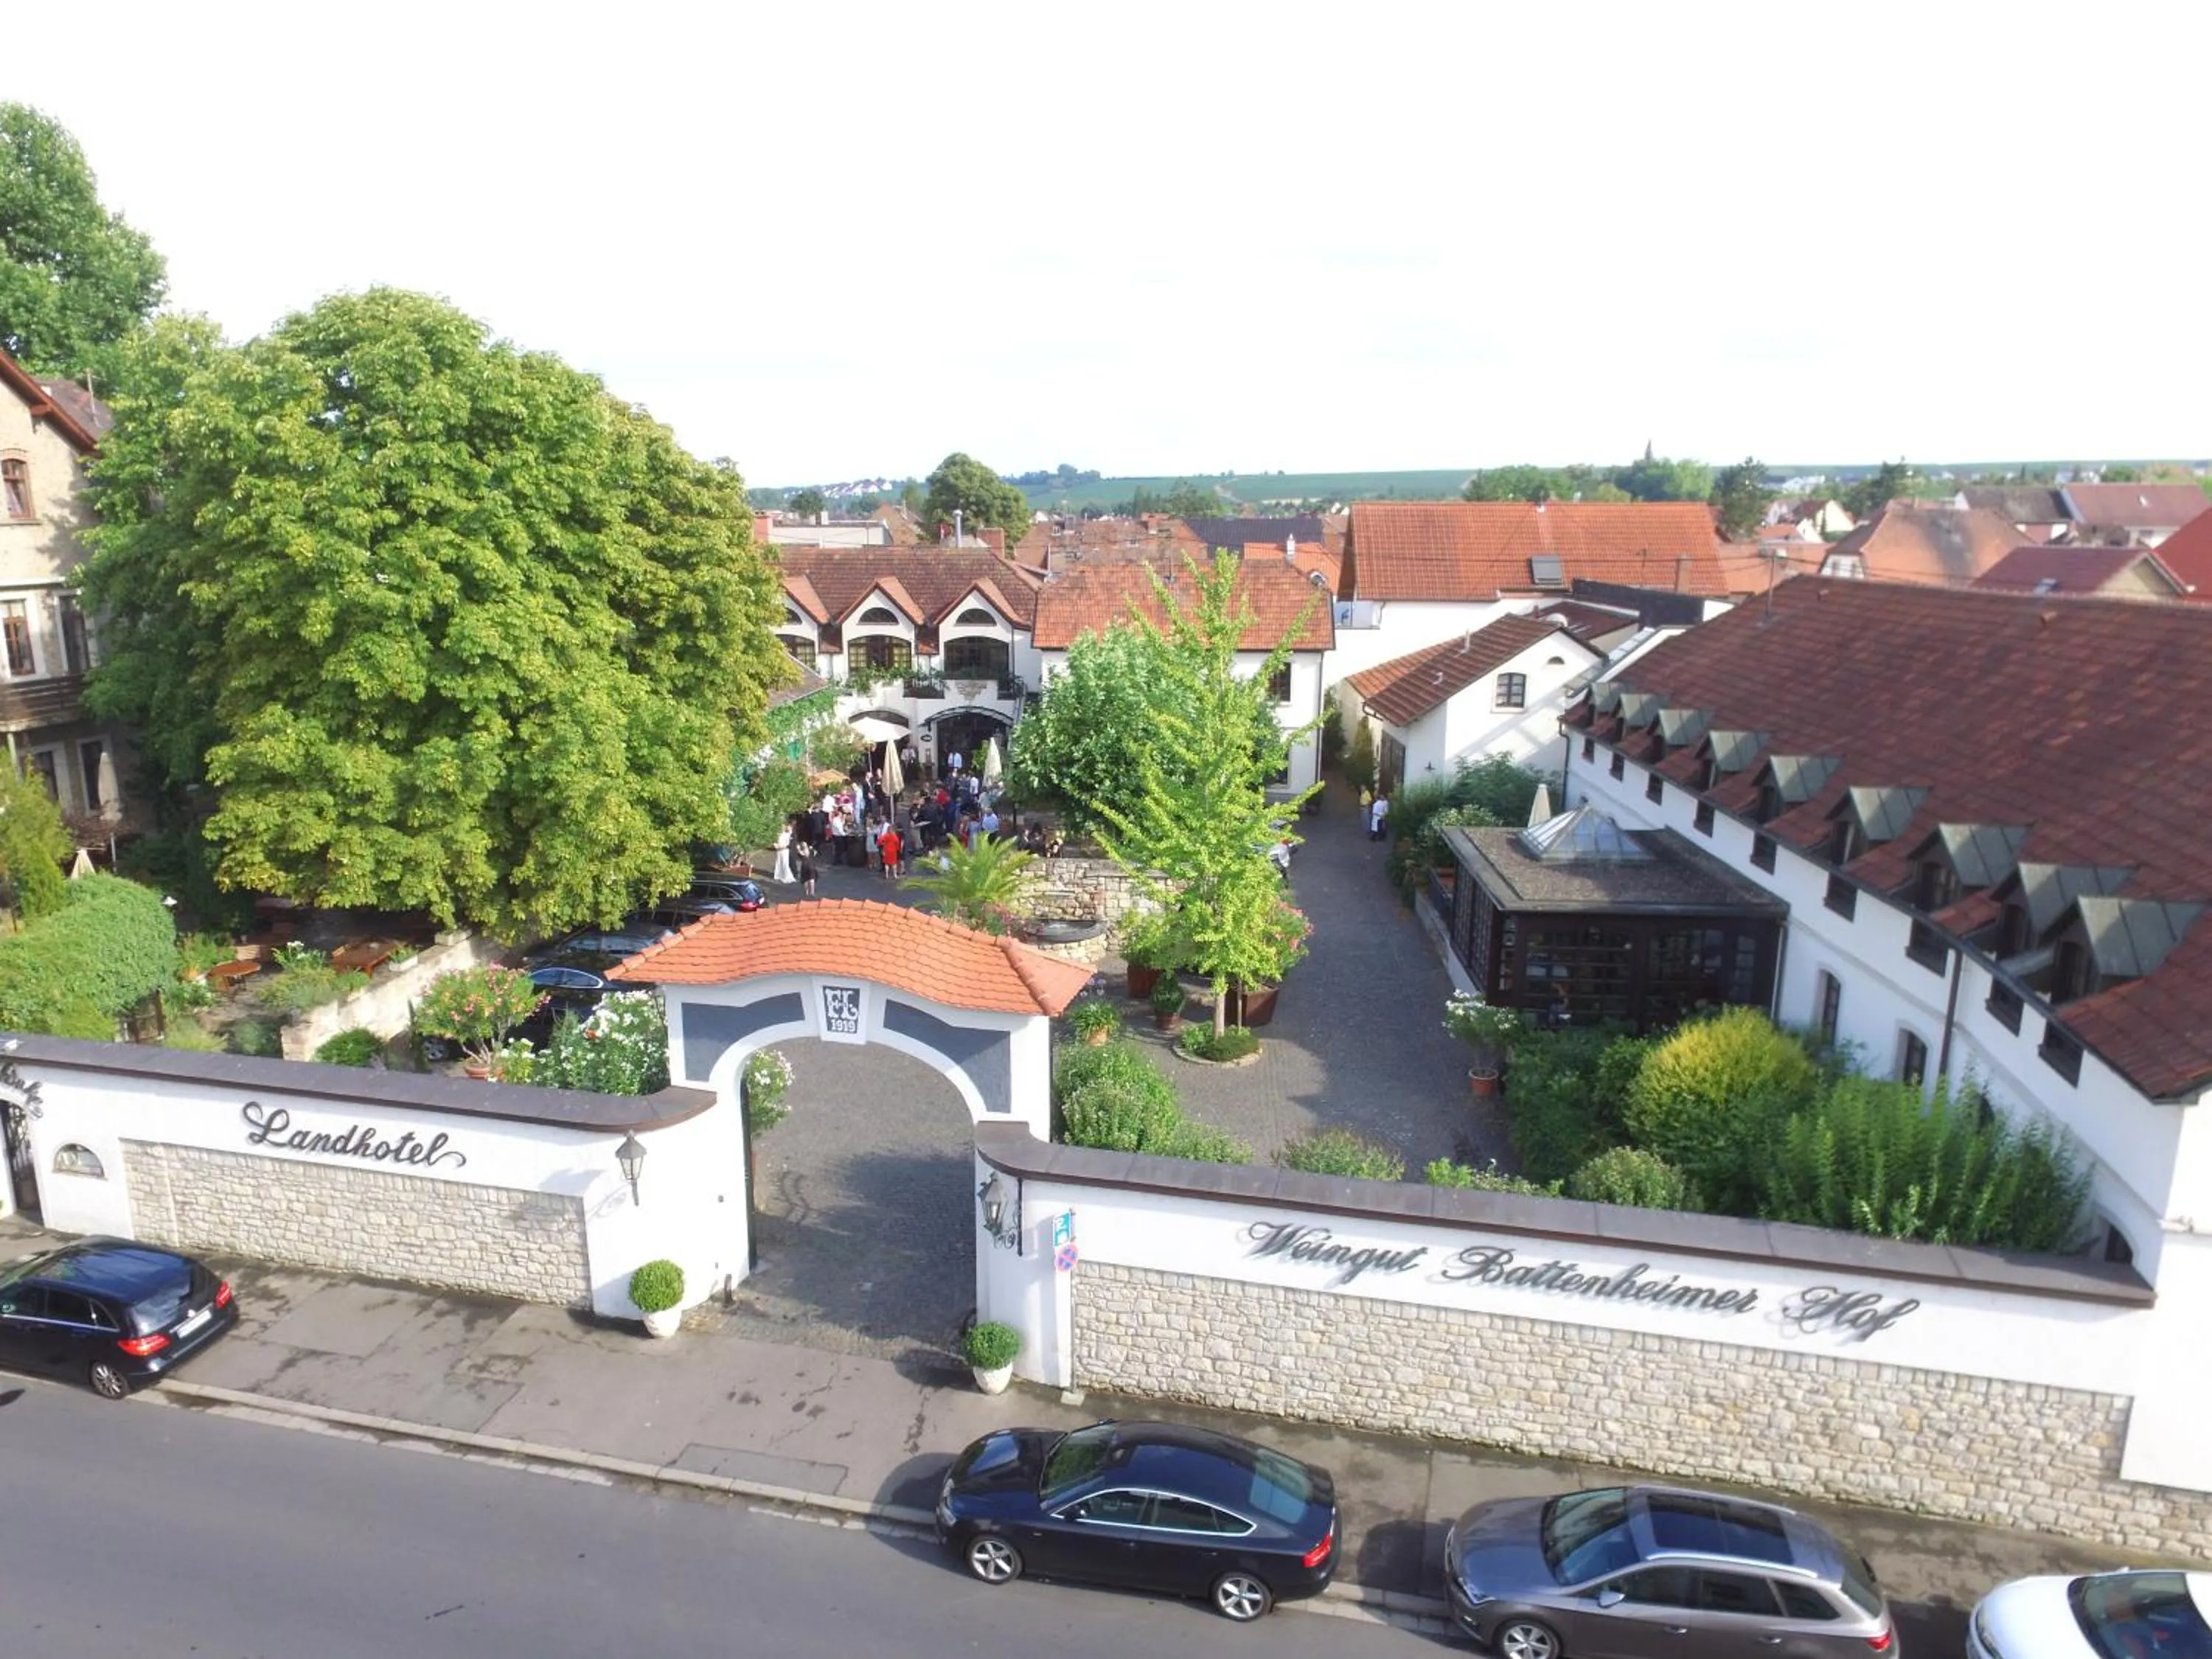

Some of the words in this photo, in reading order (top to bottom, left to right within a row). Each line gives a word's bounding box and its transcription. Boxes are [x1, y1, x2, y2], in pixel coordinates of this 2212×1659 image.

[830, 1019, 855, 1032] 1919
[243, 1101, 466, 1167] Landhotel
[1248, 1221, 1427, 1284] Weingut
[1441, 1245, 1759, 1313] Battenheimer
[1783, 1285, 1920, 1342] Hof
